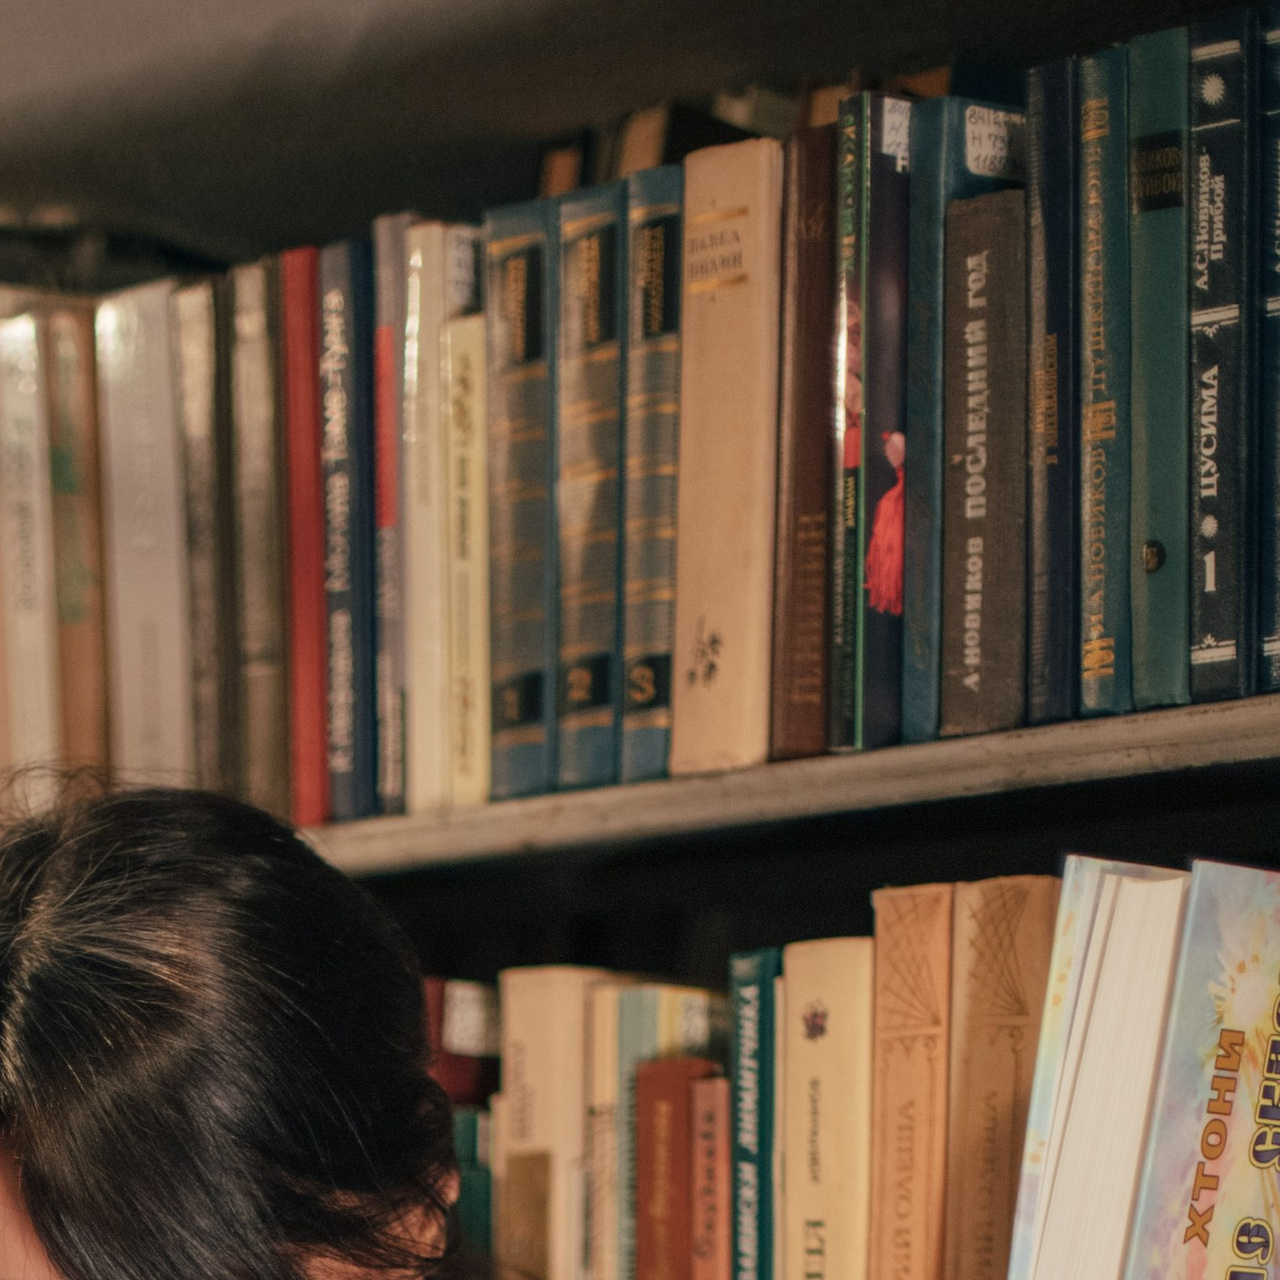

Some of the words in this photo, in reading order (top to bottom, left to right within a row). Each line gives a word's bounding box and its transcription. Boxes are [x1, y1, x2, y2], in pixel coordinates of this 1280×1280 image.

[967, 250, 990, 307] ГОД
[1209, 175, 1227, 260] Прибой
[965, 318, 989, 521] ПОСЛЕДНИЙ
[1200, 364, 1219, 501] ЦУСИМА
[1201, 550, 1217, 594] 1
[628, 665, 655, 702] 3
[737, 984, 761, 1154] ЛИМИТЧИКА
[894, 1098, 916, 1226] ОЛЕША
[1183, 1028, 1246, 1250] ХТОНИ
